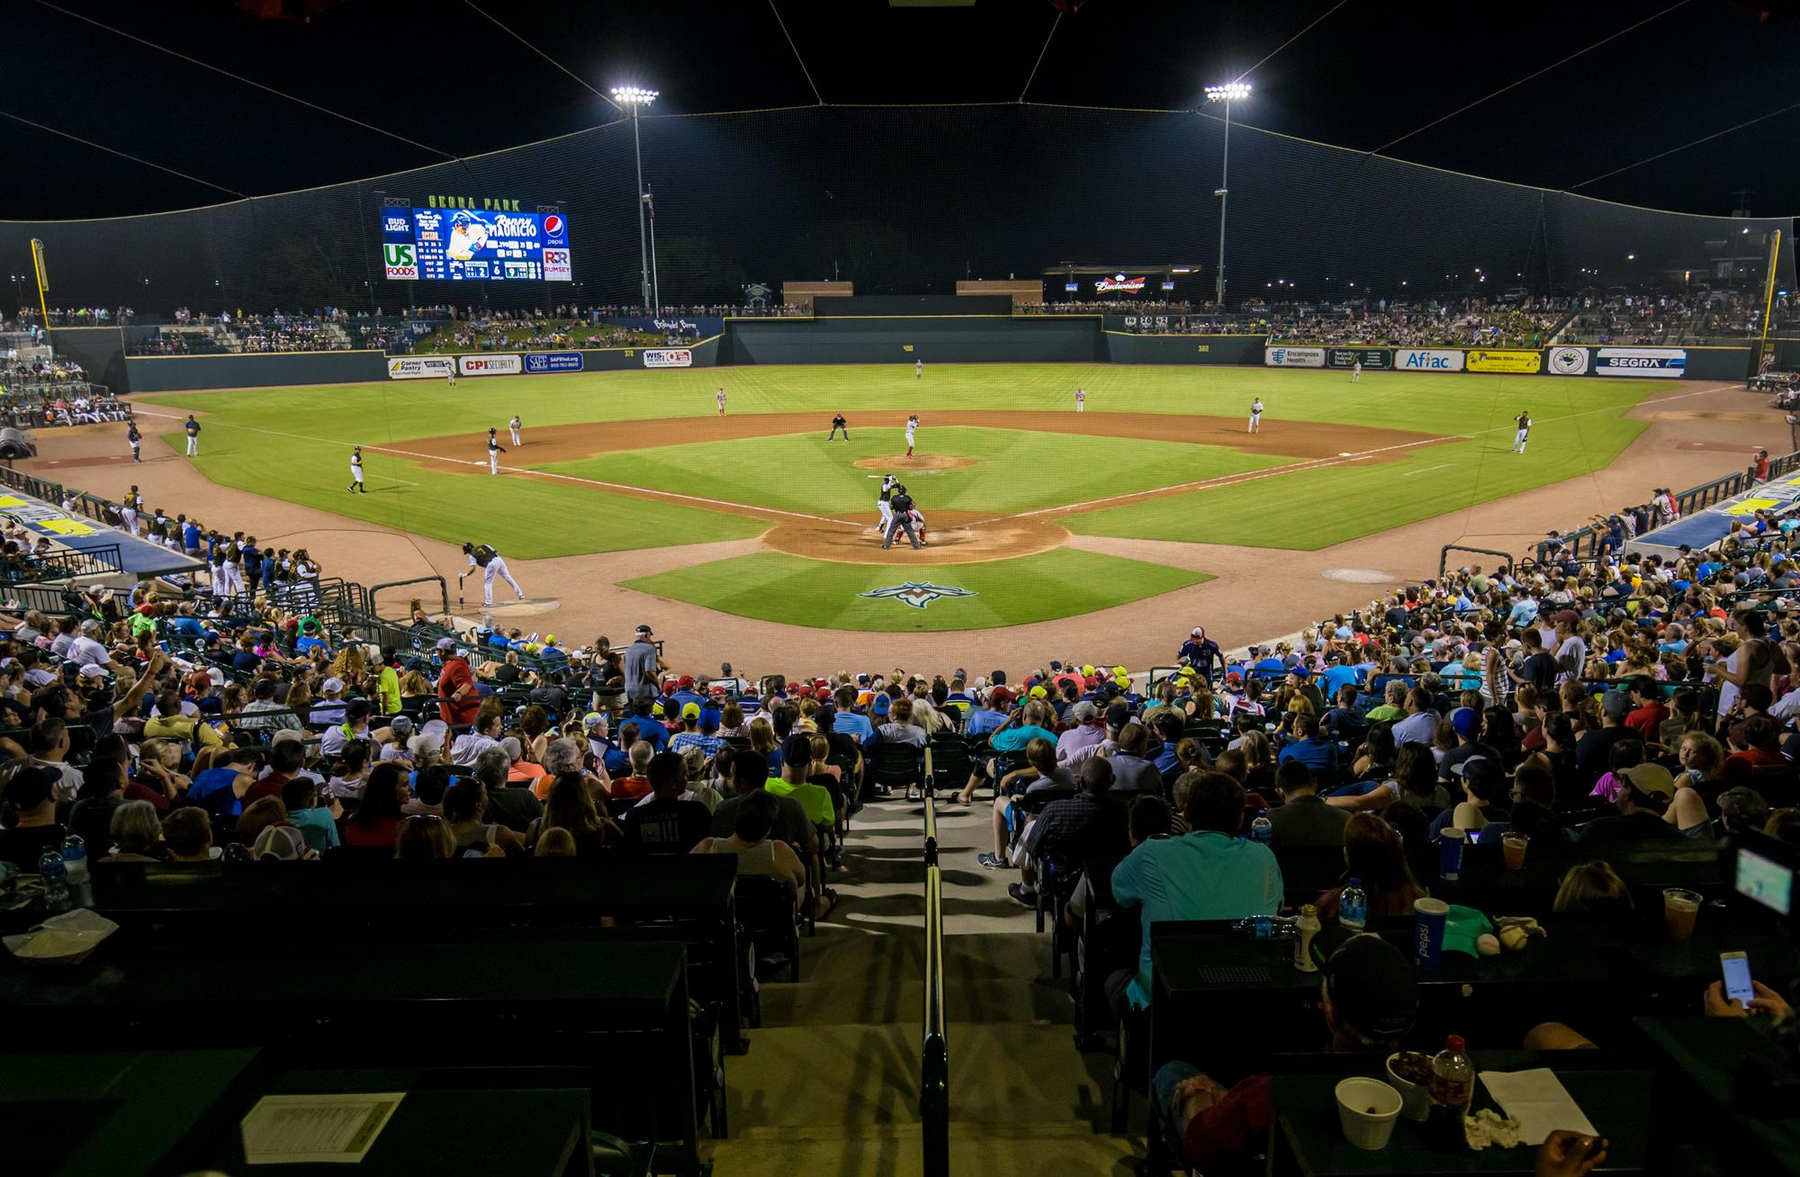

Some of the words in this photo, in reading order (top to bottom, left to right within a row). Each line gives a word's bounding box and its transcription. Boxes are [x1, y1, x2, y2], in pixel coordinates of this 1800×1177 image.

[428, 195, 475, 209] SEGRA
[484, 198, 520, 212] PARK
[388, 218, 406, 226] BUD
[495, 215, 532, 229] Ronny
[489, 224, 537, 237] MAURICIO
[547, 239, 563, 247] pepsi
[387, 267, 415, 276] FOODS
[479, 267, 485, 277] 2
[494, 266, 500, 275] 6
[509, 268, 515, 277] 9
[1095, 281, 1145, 291] Budweiser
[466, 360, 488, 371] CPI
[489, 359, 515, 369] SECURITY
[530, 354, 547, 369] SAFE
[1406, 352, 1449, 369] Aflac
[1609, 358, 1660, 368] SEGRA
[1418, 922, 1430, 957] pepsi
